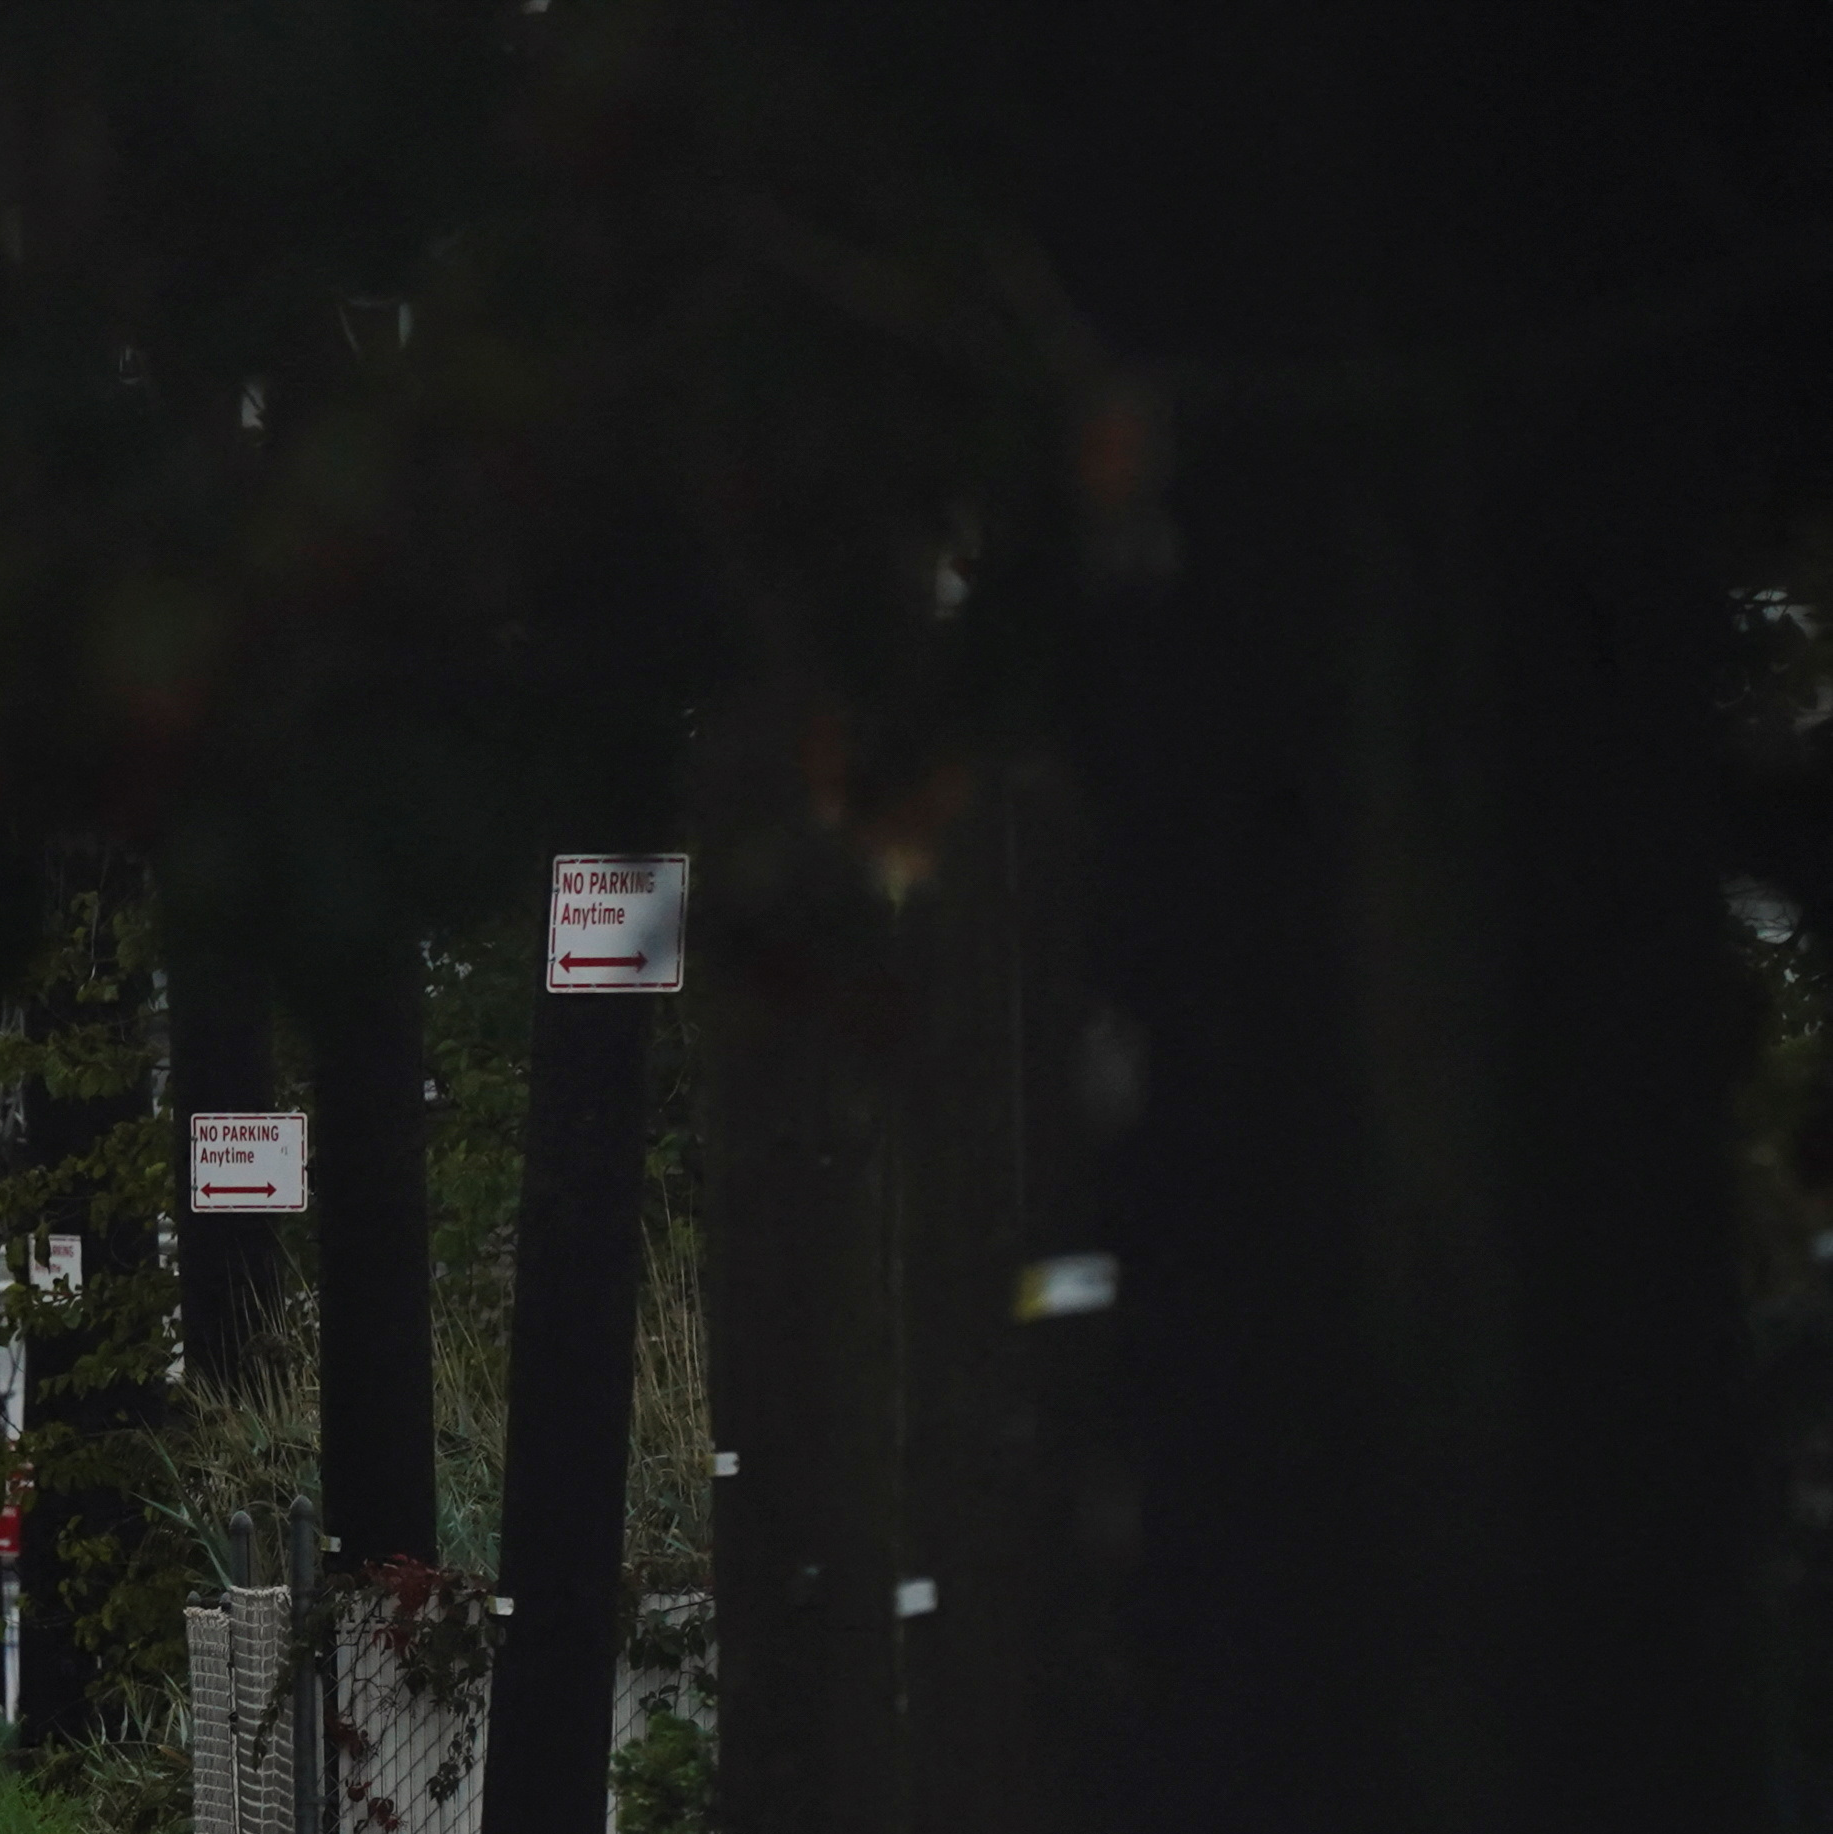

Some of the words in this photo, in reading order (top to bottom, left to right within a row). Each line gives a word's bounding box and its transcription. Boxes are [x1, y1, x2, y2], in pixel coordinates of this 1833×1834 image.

[562, 872, 583, 894] NO
[589, 871, 655, 894] PARKING
[560, 902, 625, 931] Anytime
[199, 1125, 218, 1142] NO
[222, 1125, 279, 1142] PARKING
[200, 1147, 255, 1167] Anytime
